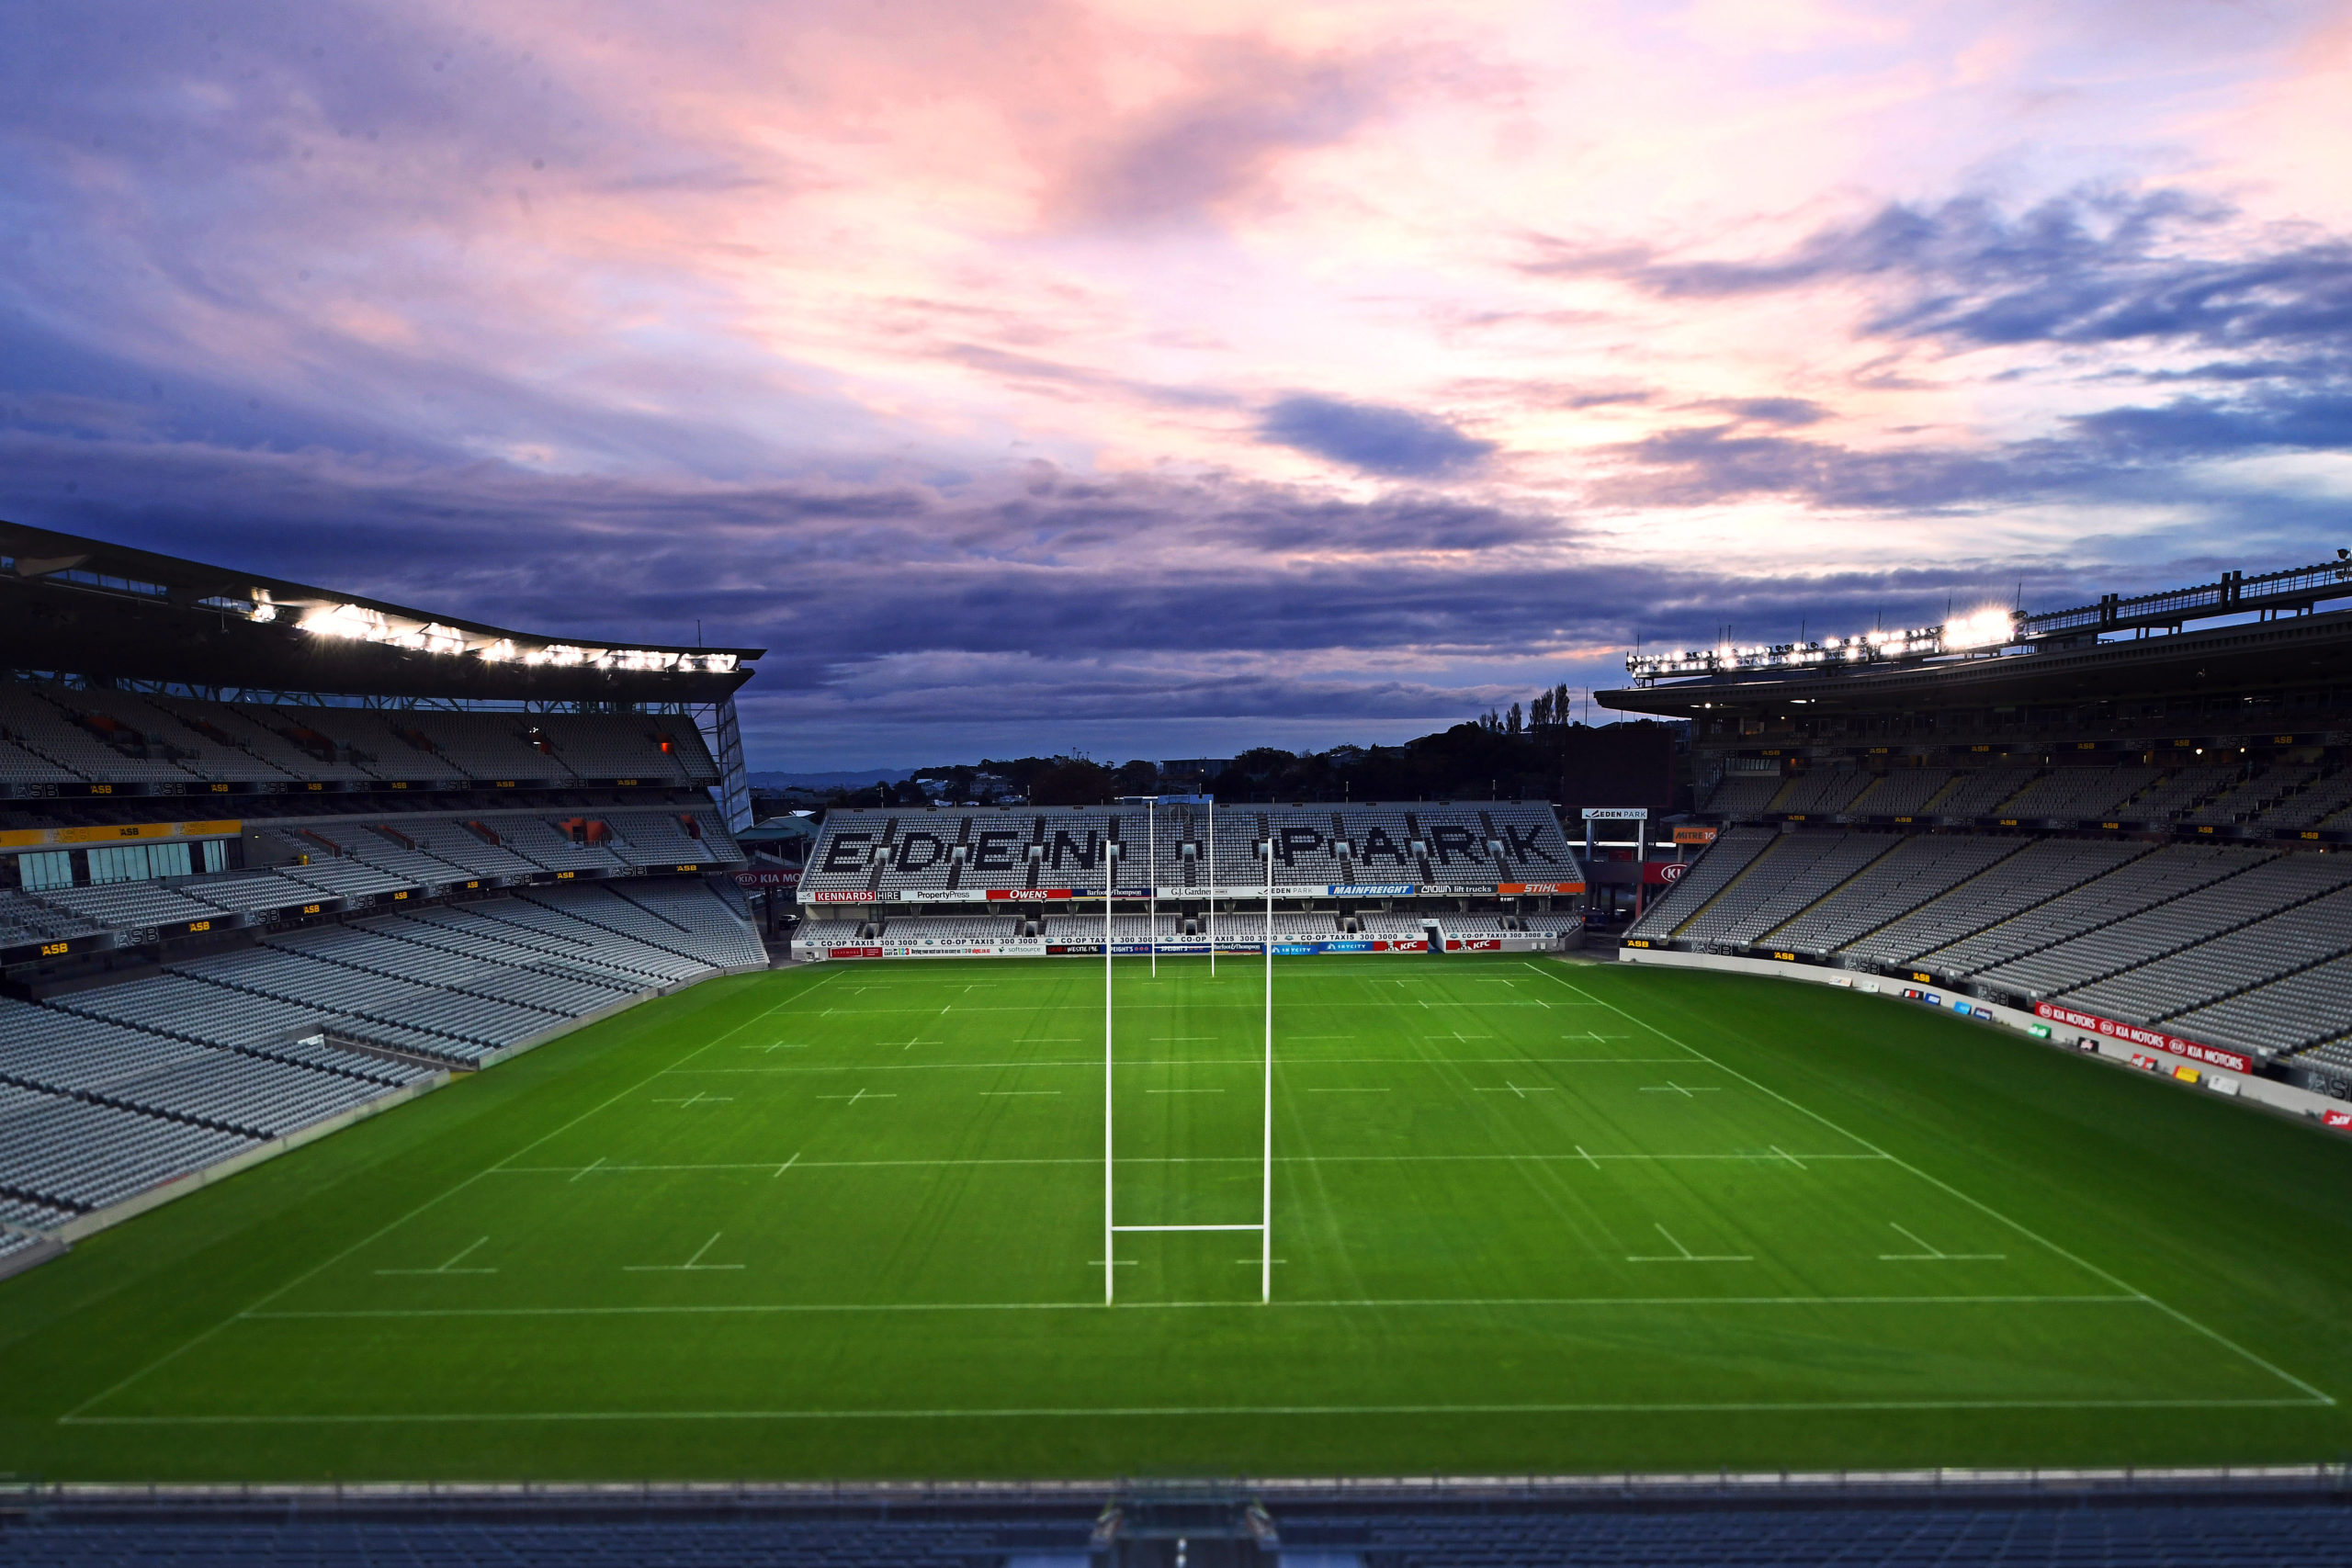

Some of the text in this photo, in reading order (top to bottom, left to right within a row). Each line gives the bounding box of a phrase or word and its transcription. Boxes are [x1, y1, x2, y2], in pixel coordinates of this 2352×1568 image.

[308, 783, 322, 792] ASB
[391, 782, 407, 791] ASB
[496, 780, 515, 789] ASB
[616, 779, 638, 788] ASB
[91, 784, 112, 794] ASB
[211, 783, 229, 794] ASB
[120, 828, 140, 837] ASB
[822, 825, 1557, 873] EDEN PARK
[737, 874, 754, 884] KIA
[761, 874, 780, 883] KIA
[1333, 886, 1409, 894] MAINFREIGHT
[1523, 884, 1559, 893] STIHL
[394, 891, 409, 900] ASB
[818, 892, 874, 900] KENNARDS
[877, 892, 899, 900] HIRE
[917, 891, 970, 899] PropertyPress
[1010, 889, 1048, 899] OWENS
[303, 905, 320, 914] ASB
[189, 921, 210, 932] ASB
[114, 927, 160, 949] ASB
[1400, 942, 1418, 950] KFC
[1473, 940, 1490, 949] KFC
[1627, 940, 1649, 948] ASB
[41, 943, 69, 956] ASB
[1774, 952, 1794, 961] ASB
[1912, 972, 1930, 983] ASB
[2053, 1009, 2065, 1021] KIA
[2066, 1012, 2096, 1029] MOTORS
[2115, 1025, 2129, 1037] KIA
[2130, 1029, 2164, 1048] MOTORS
[2187, 1045, 2203, 1057] KIA
[2203, 1049, 2244, 1071] MOTORS
